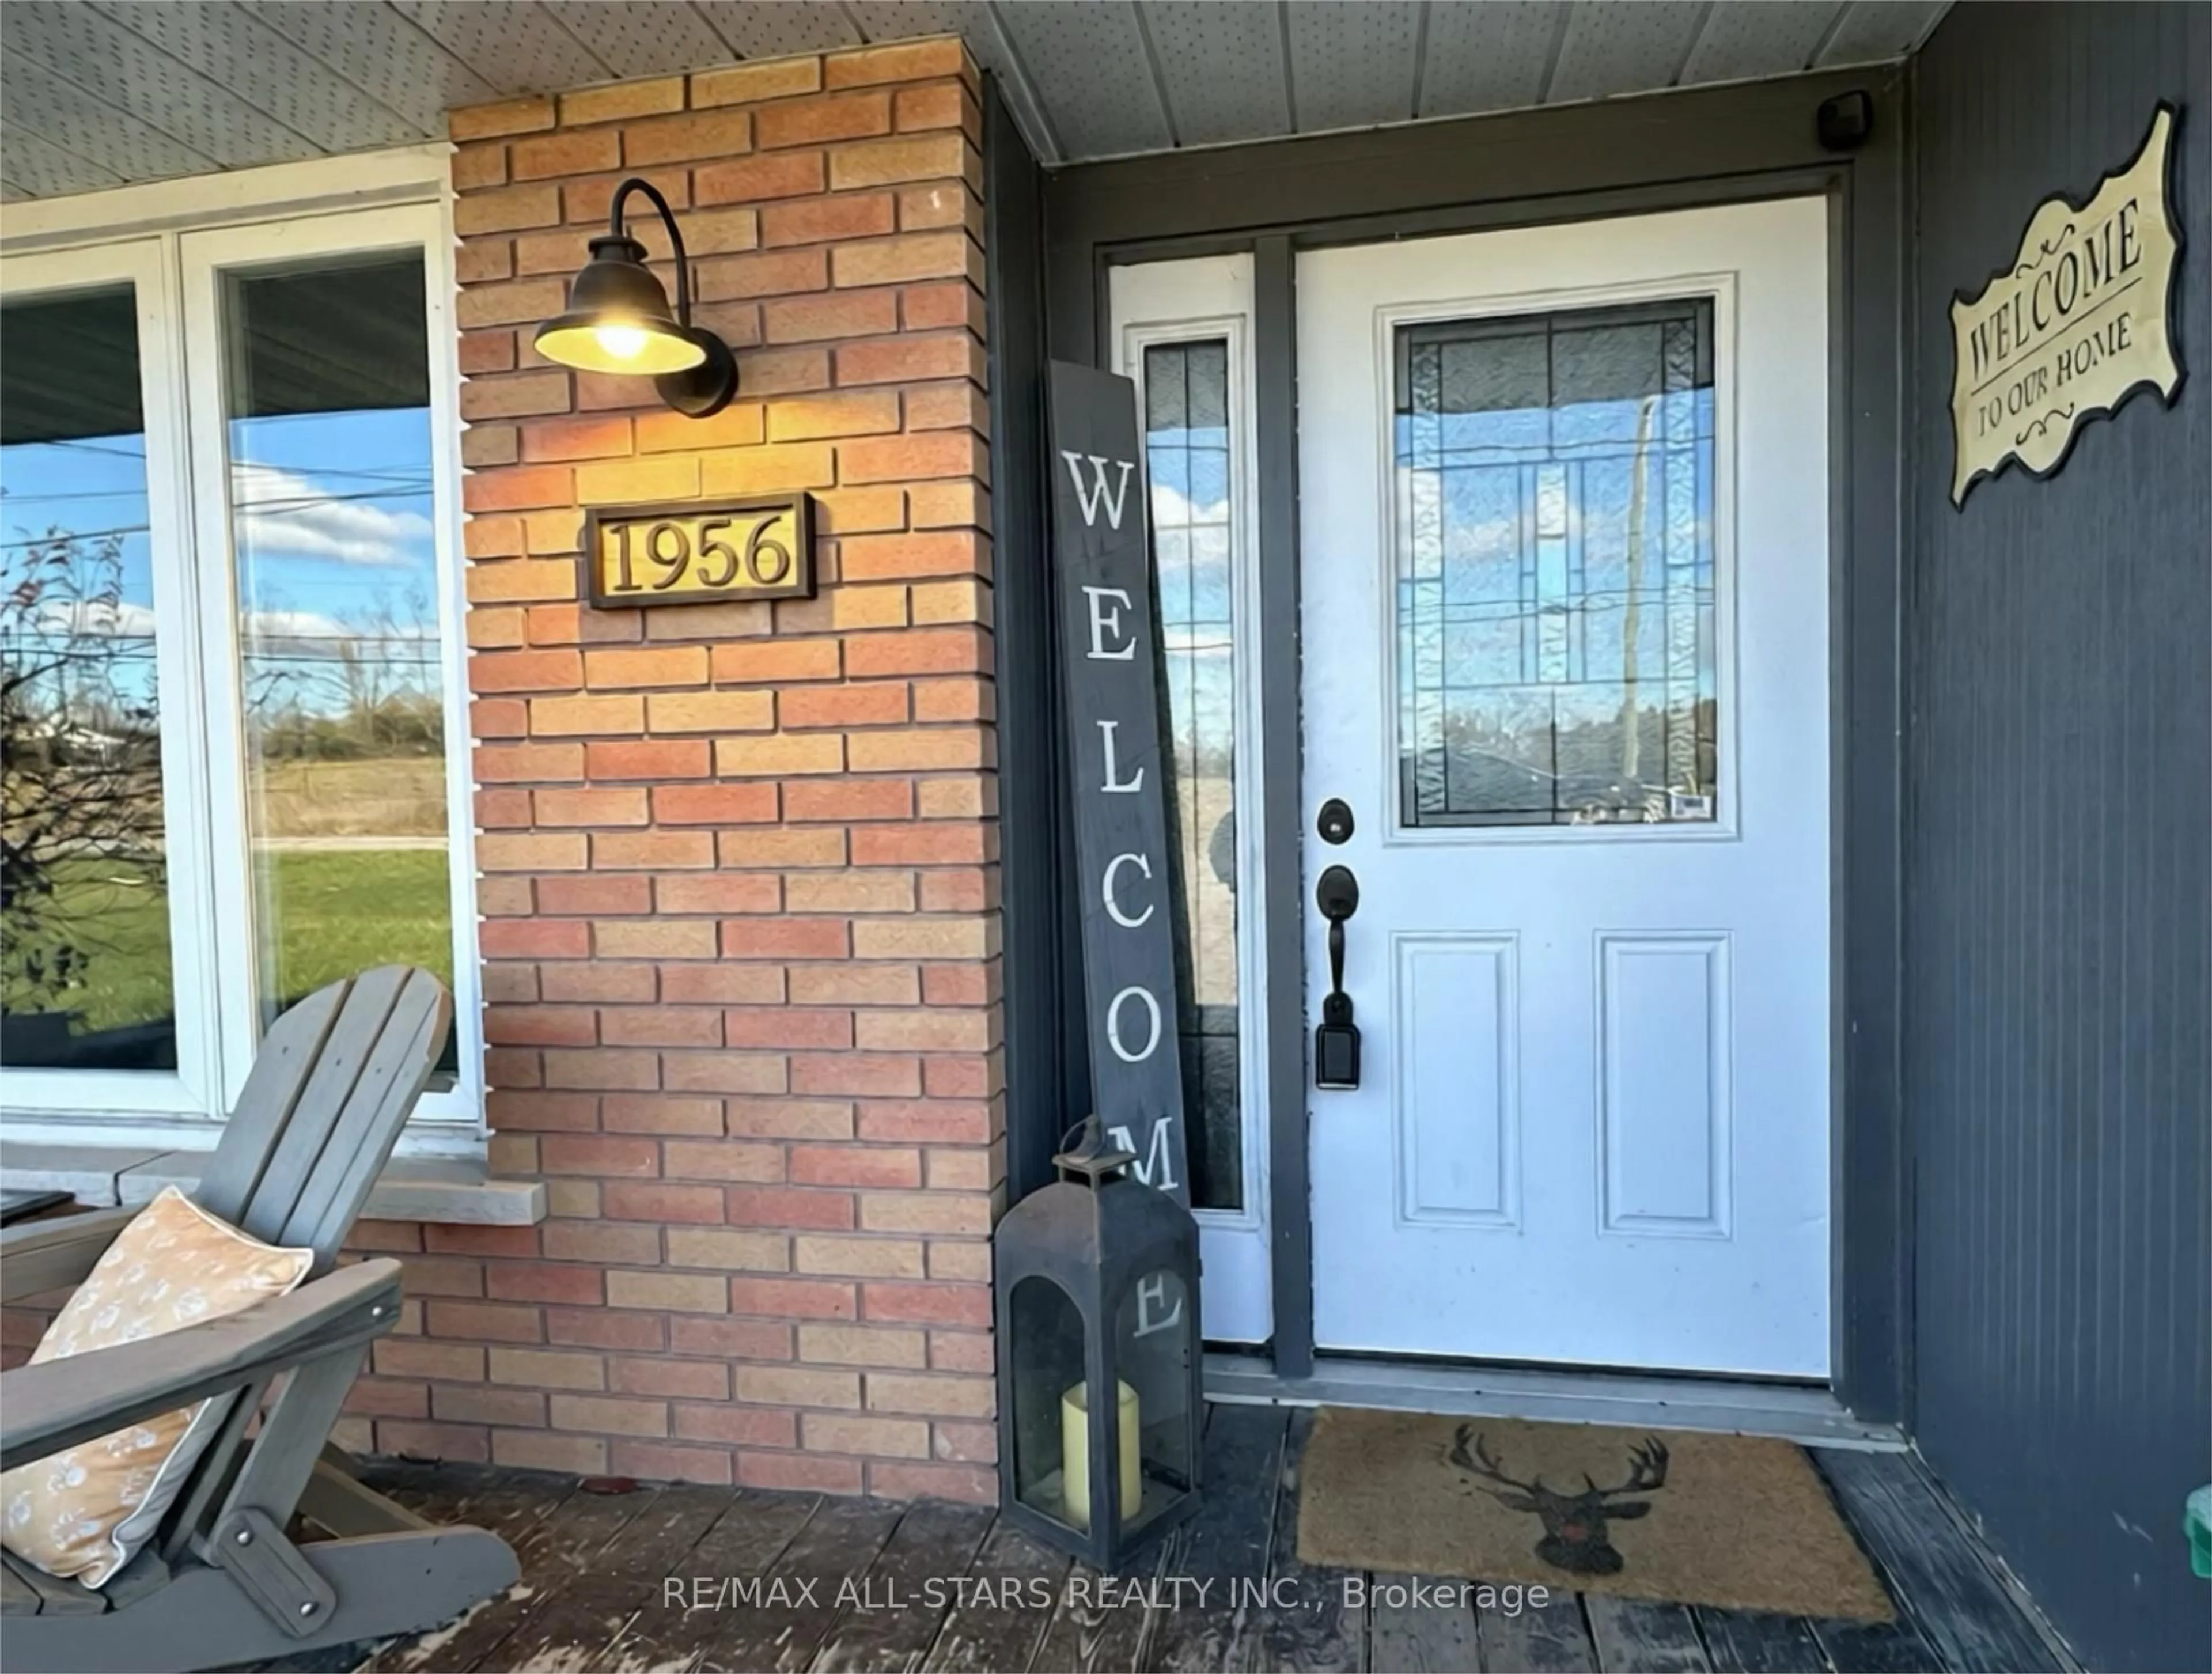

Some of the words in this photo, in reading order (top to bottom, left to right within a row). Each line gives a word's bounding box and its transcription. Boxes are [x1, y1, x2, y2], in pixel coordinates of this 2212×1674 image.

[1970, 198, 2142, 382] WELCOME
[1978, 397, 2002, 437] TO
[2008, 366, 2048, 416] OUR
[2056, 311, 2132, 388] HOME
[609, 516, 791, 591] 1956
[1060, 450, 1182, 1338] WELCOME
